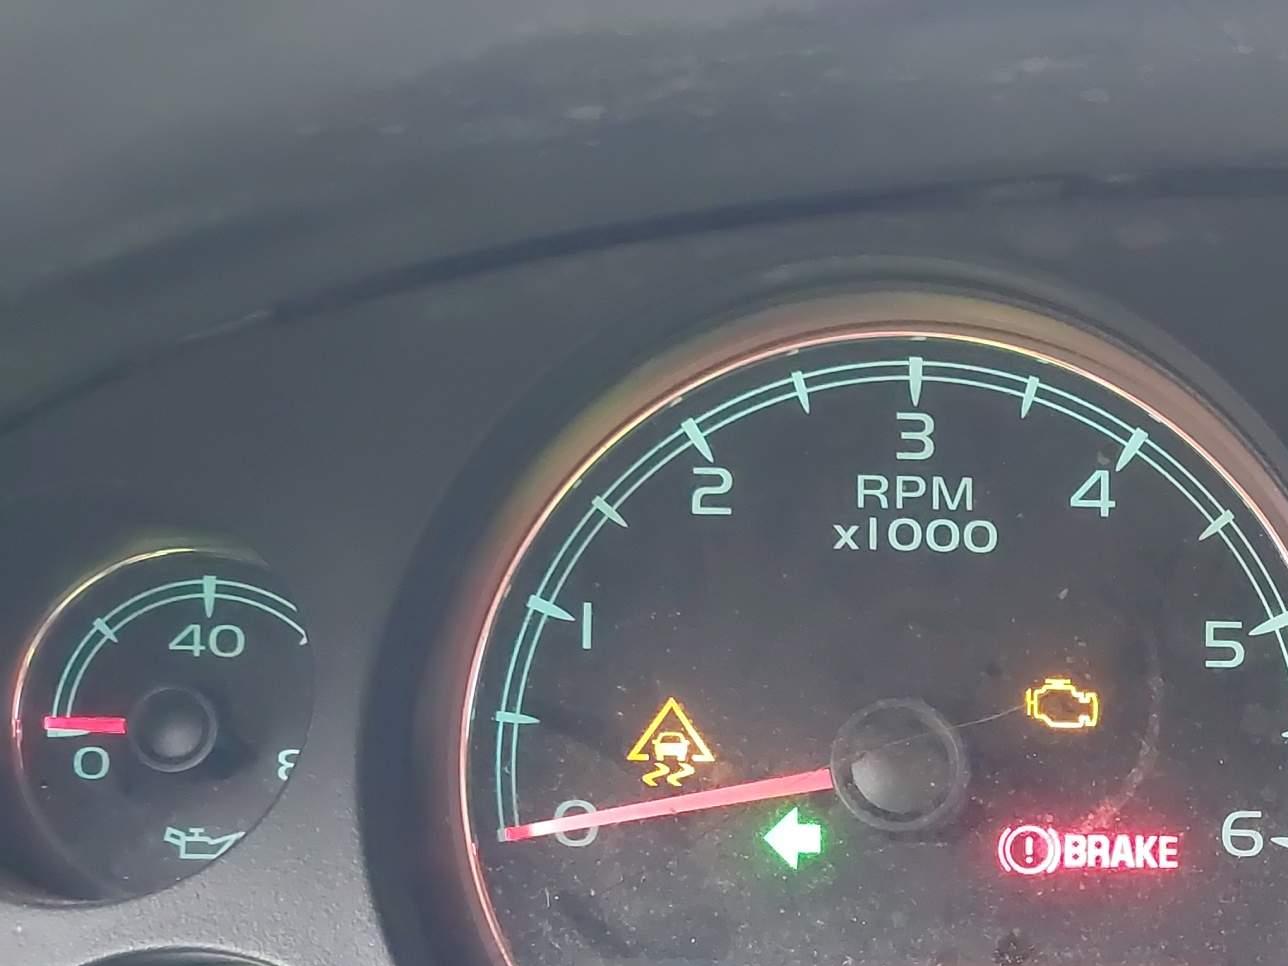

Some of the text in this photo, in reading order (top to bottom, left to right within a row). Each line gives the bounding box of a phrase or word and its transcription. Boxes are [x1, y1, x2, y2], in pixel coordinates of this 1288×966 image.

[897, 413, 935, 460] 3
[691, 467, 732, 515] 2
[857, 475, 974, 511] RPM
[1070, 470, 1115, 517] 4
[833, 518, 998, 554] x1000
[168, 624, 245, 658] 40
[582, 602, 592, 650] 1
[1206, 621, 1244, 668] 5
[73, 746, 110, 779] 0
[1063, 834, 1179, 869] BRAKE
[1222, 811, 1263, 858] 6
